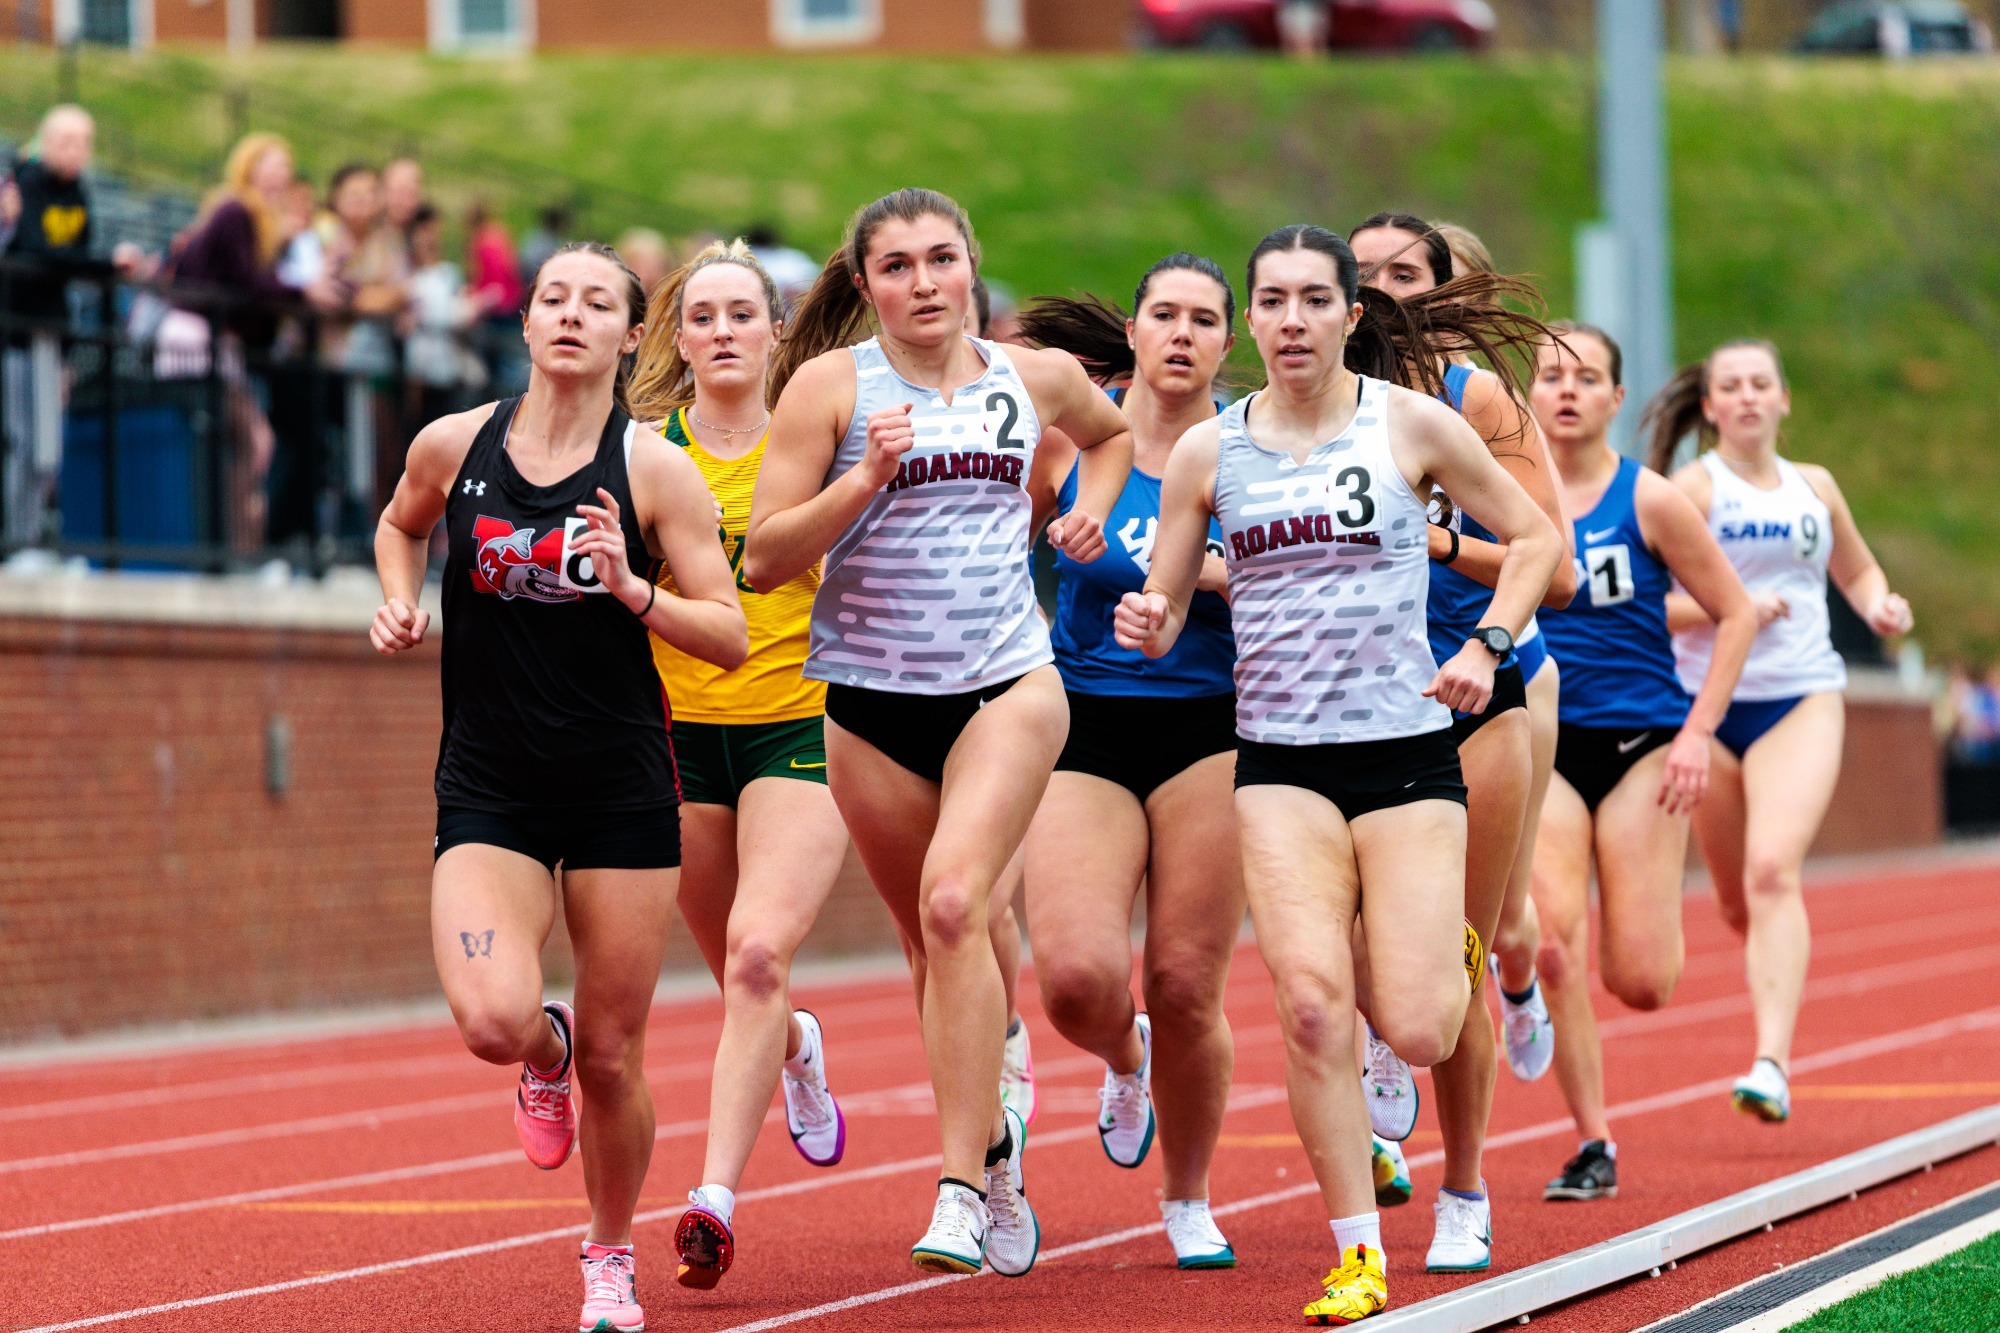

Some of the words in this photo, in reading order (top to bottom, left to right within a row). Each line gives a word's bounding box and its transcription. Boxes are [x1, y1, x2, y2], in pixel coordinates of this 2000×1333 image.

[985, 391, 1025, 450] 2
[887, 452, 1024, 493] ROANOKE
[1335, 465, 1375, 528] 3
[1801, 513, 1818, 557] 9
[1593, 556, 1620, 597] 1
